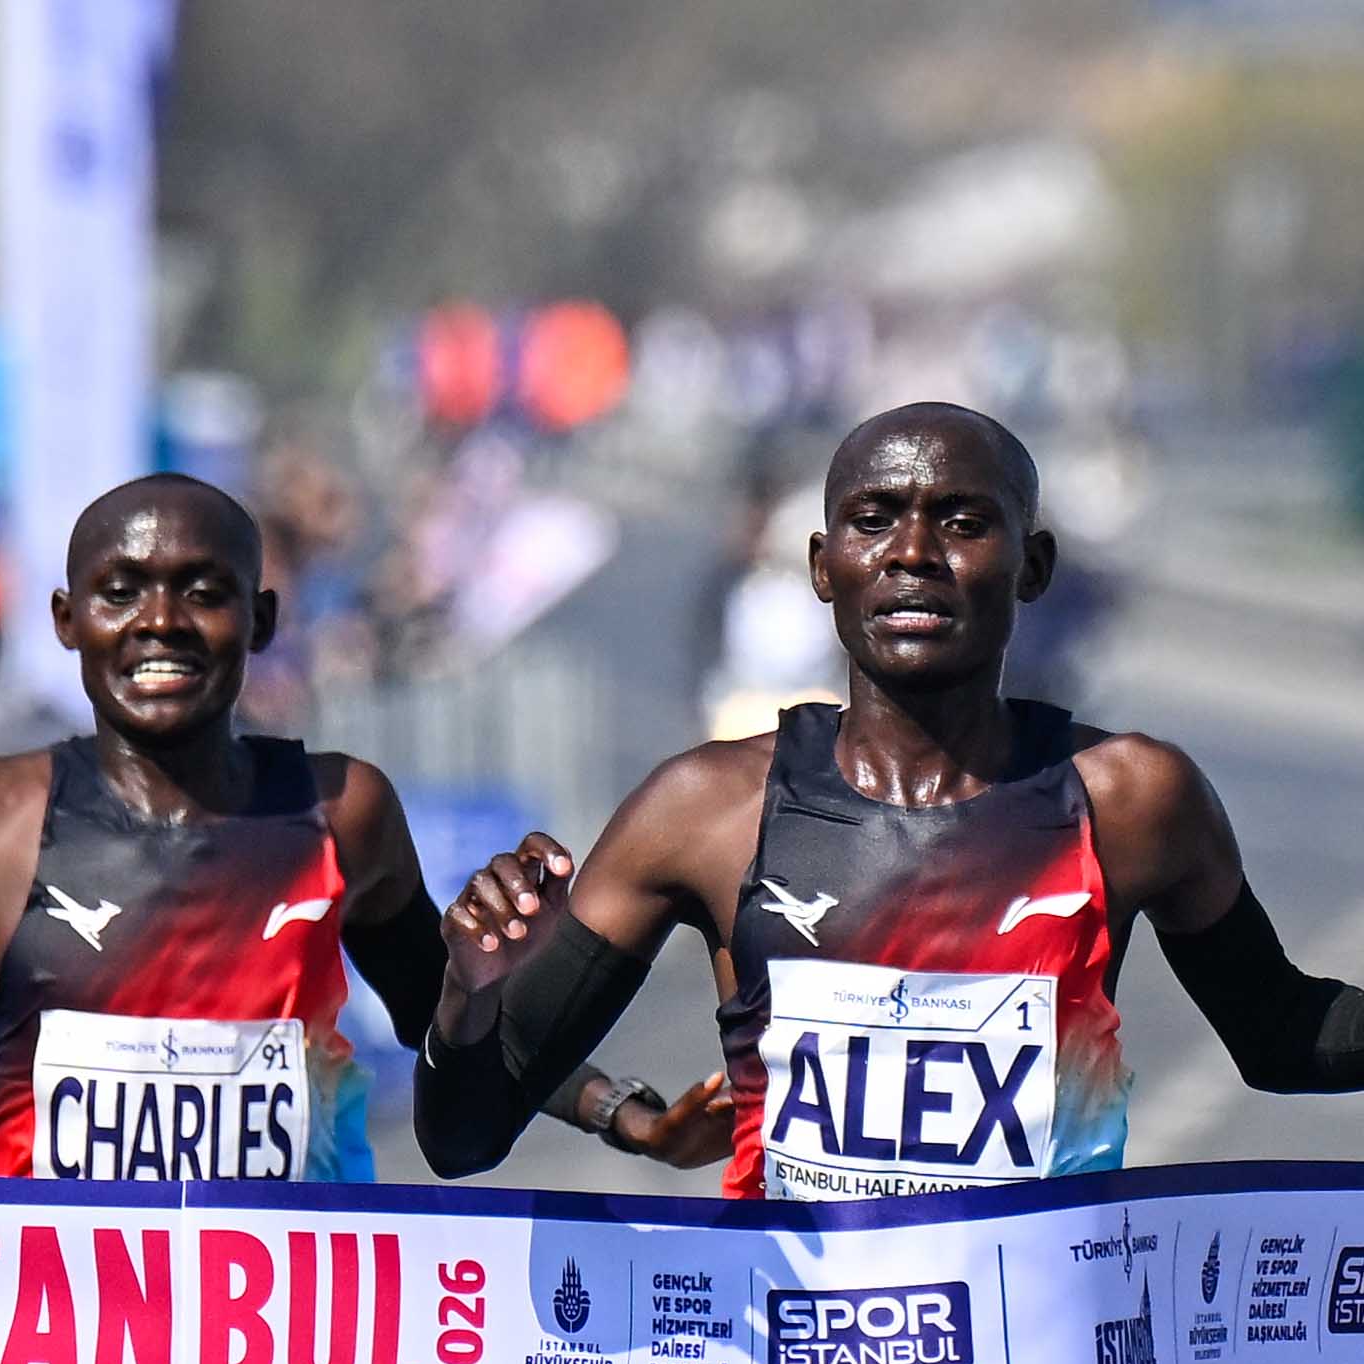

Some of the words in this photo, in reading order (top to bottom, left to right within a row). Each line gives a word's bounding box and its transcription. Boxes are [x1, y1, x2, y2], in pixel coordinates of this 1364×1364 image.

[911, 996, 972, 1010] BANKASI
[1016, 1001, 1032, 1030] 1
[263, 1043, 290, 1070] 91
[770, 1031, 1044, 1168] ALEX
[50, 1076, 294, 1181] CHARLES
[1260, 1234, 1306, 1256] GENÇLİK
[1256, 1260, 1269, 1275] VE
[1270, 1260, 1298, 1275] SPOR
[652, 1272, 712, 1294] GENÇLİK
[1251, 1277, 1311, 1297] HİZMETLERİ
[653, 1296, 671, 1313] VE
[674, 1297, 712, 1315] SPOR
[778, 1293, 957, 1340] SPOR
[1249, 1299, 1287, 1320] DAİRESİ
[652, 1315, 732, 1339] HİZMETLERİ
[1248, 1321, 1307, 1344] BAŞKANLIĞI
[540, 1339, 601, 1354] İSTANBUL
[650, 1338, 706, 1360] DAİRESİ
